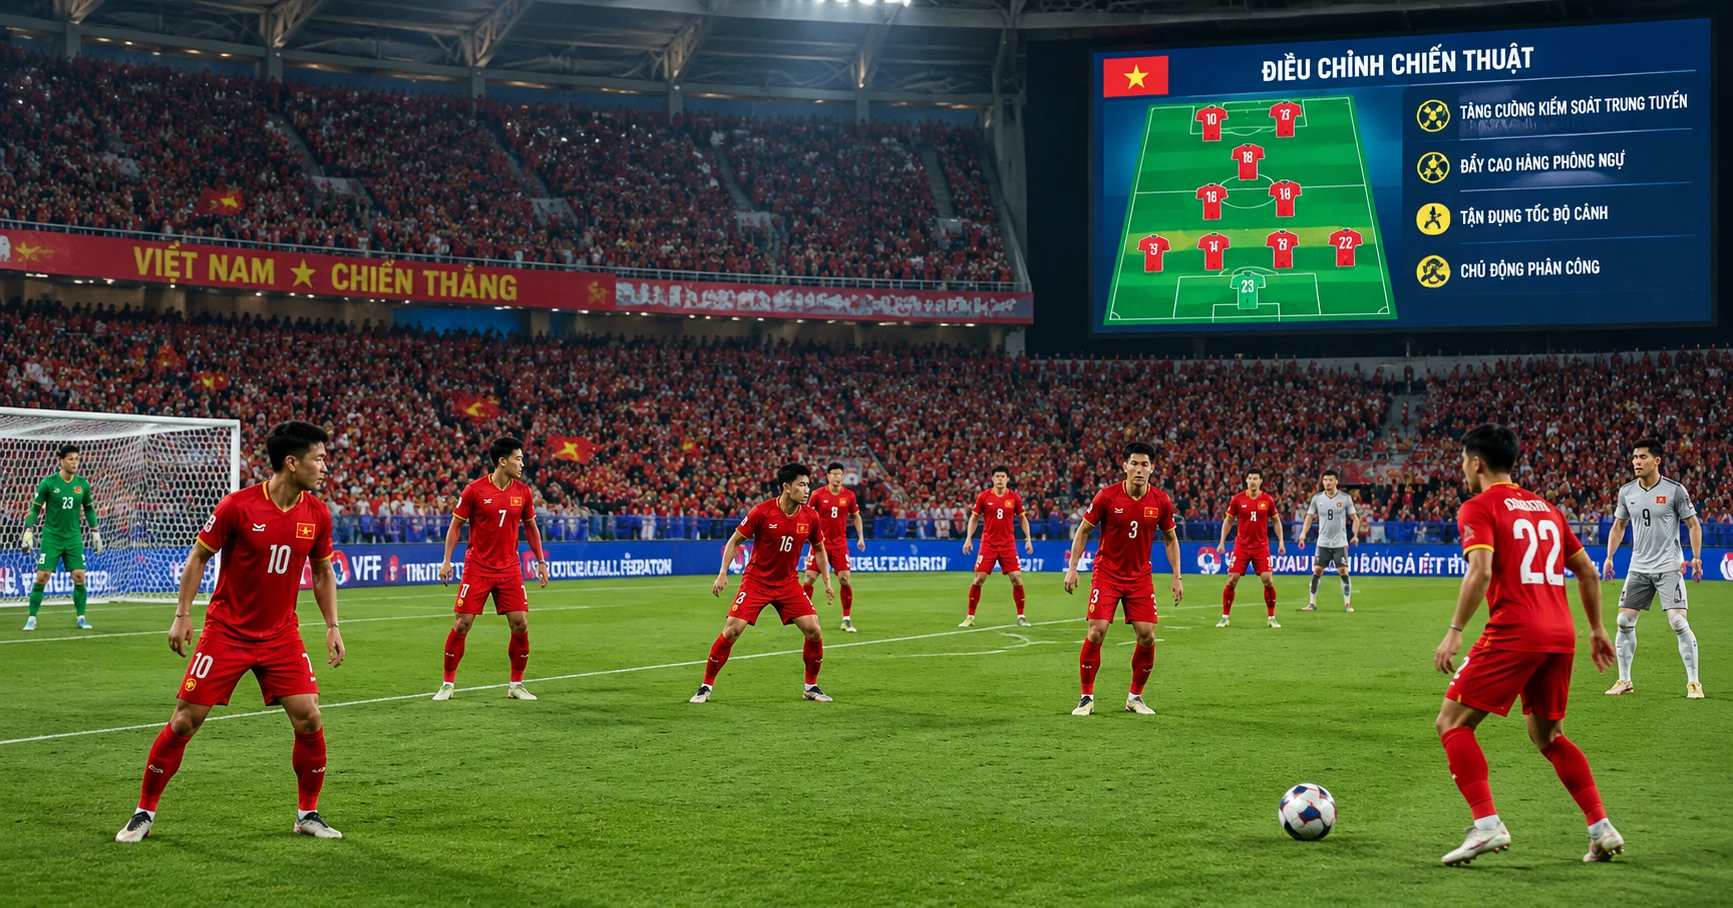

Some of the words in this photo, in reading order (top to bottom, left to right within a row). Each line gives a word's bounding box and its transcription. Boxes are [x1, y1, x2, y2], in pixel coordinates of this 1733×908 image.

[1262, 52, 1311, 82] ĐIỀU
[1317, 50, 1384, 79] CHỈNH
[1392, 43, 1456, 76] CHIẾN
[1463, 42, 1534, 74] THUẬT
[1605, 96, 1645, 113] TRUNG
[1206, 113, 1217, 125] 10
[1488, 157, 1512, 172] CAO
[1460, 206, 1484, 228] TẬN
[1525, 203, 1550, 223] TỐC
[1339, 236, 1353, 249] 22
[133, 239, 198, 284] VIỆT
[208, 254, 275, 285] NAM
[1489, 258, 1524, 280] ĐỘNG
[1527, 257, 1562, 276] PHÂN
[1565, 256, 1600, 275] CÔNG
[62, 496, 73, 509] 23
[498, 509, 507, 527] 7
[831, 506, 838, 518] 8
[996, 508, 1003, 520] 8
[1642, 508, 1651, 527] 9
[1128, 520, 1138, 538] 3
[780, 535, 793, 553] 16
[1513, 518, 1564, 586] 22
[267, 544, 291, 574] 10
[351, 555, 382, 581] VFF
[1091, 589, 1099, 603] 3
[190, 652, 213, 679] 10
